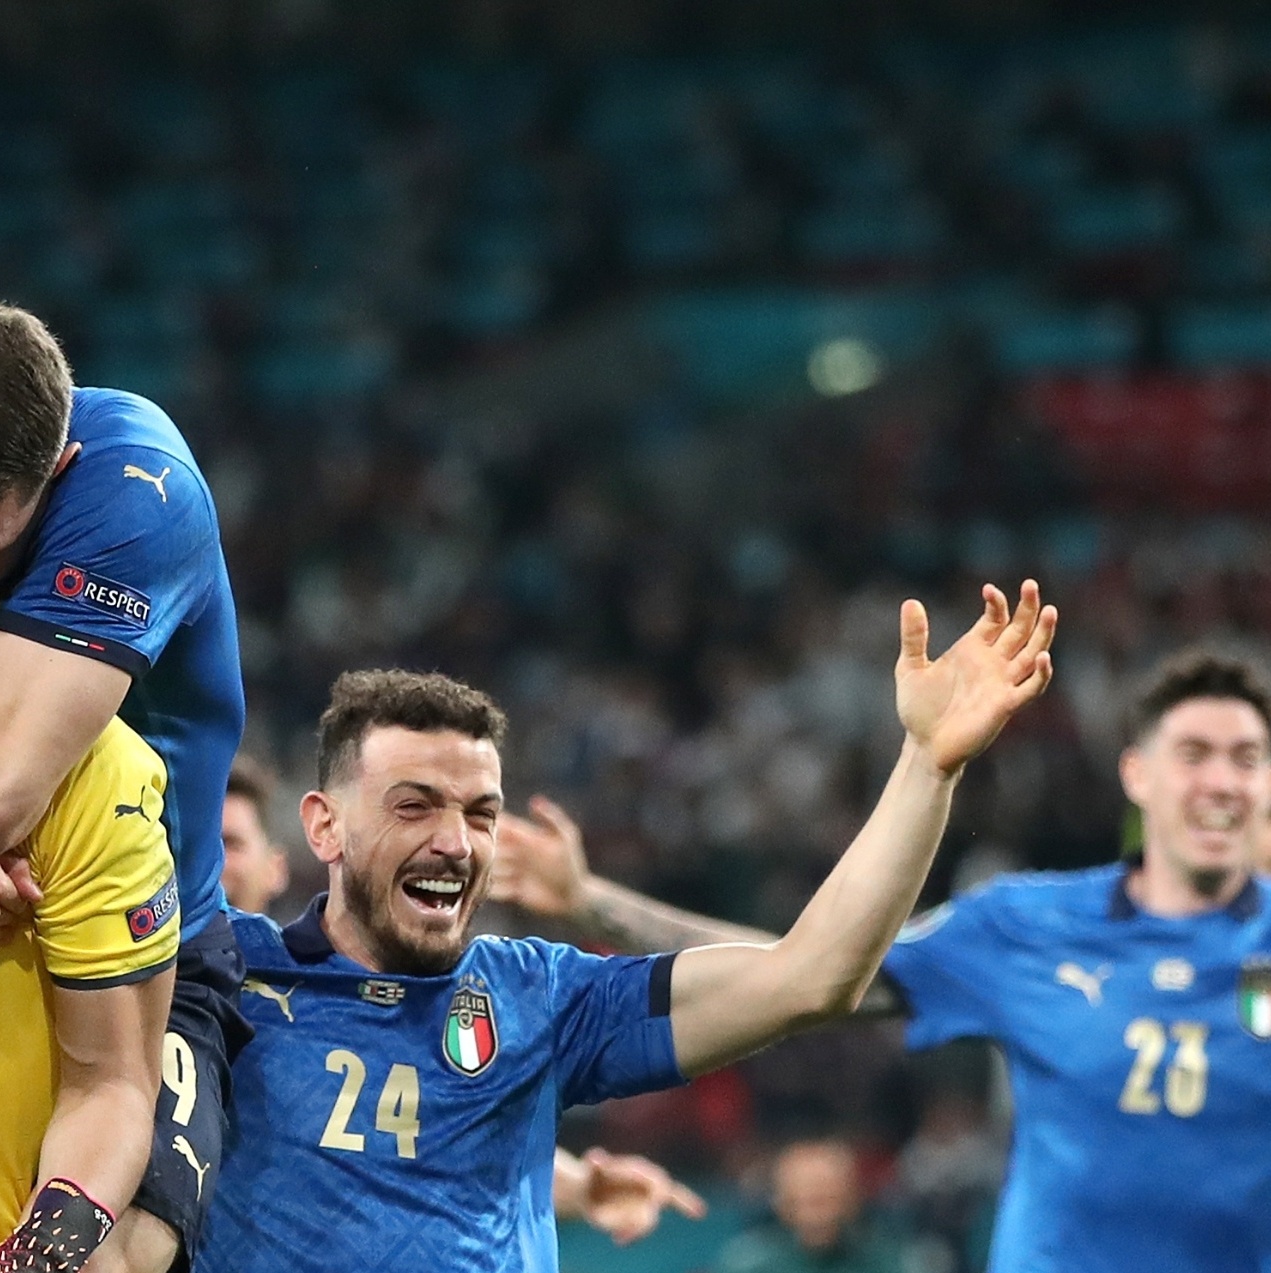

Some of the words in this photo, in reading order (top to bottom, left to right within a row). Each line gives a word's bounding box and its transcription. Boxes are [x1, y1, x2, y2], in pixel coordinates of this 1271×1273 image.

[84, 582, 150, 620] RESPECT
[161, 1032, 198, 1127] 9
[319, 1049, 420, 1160] 24
